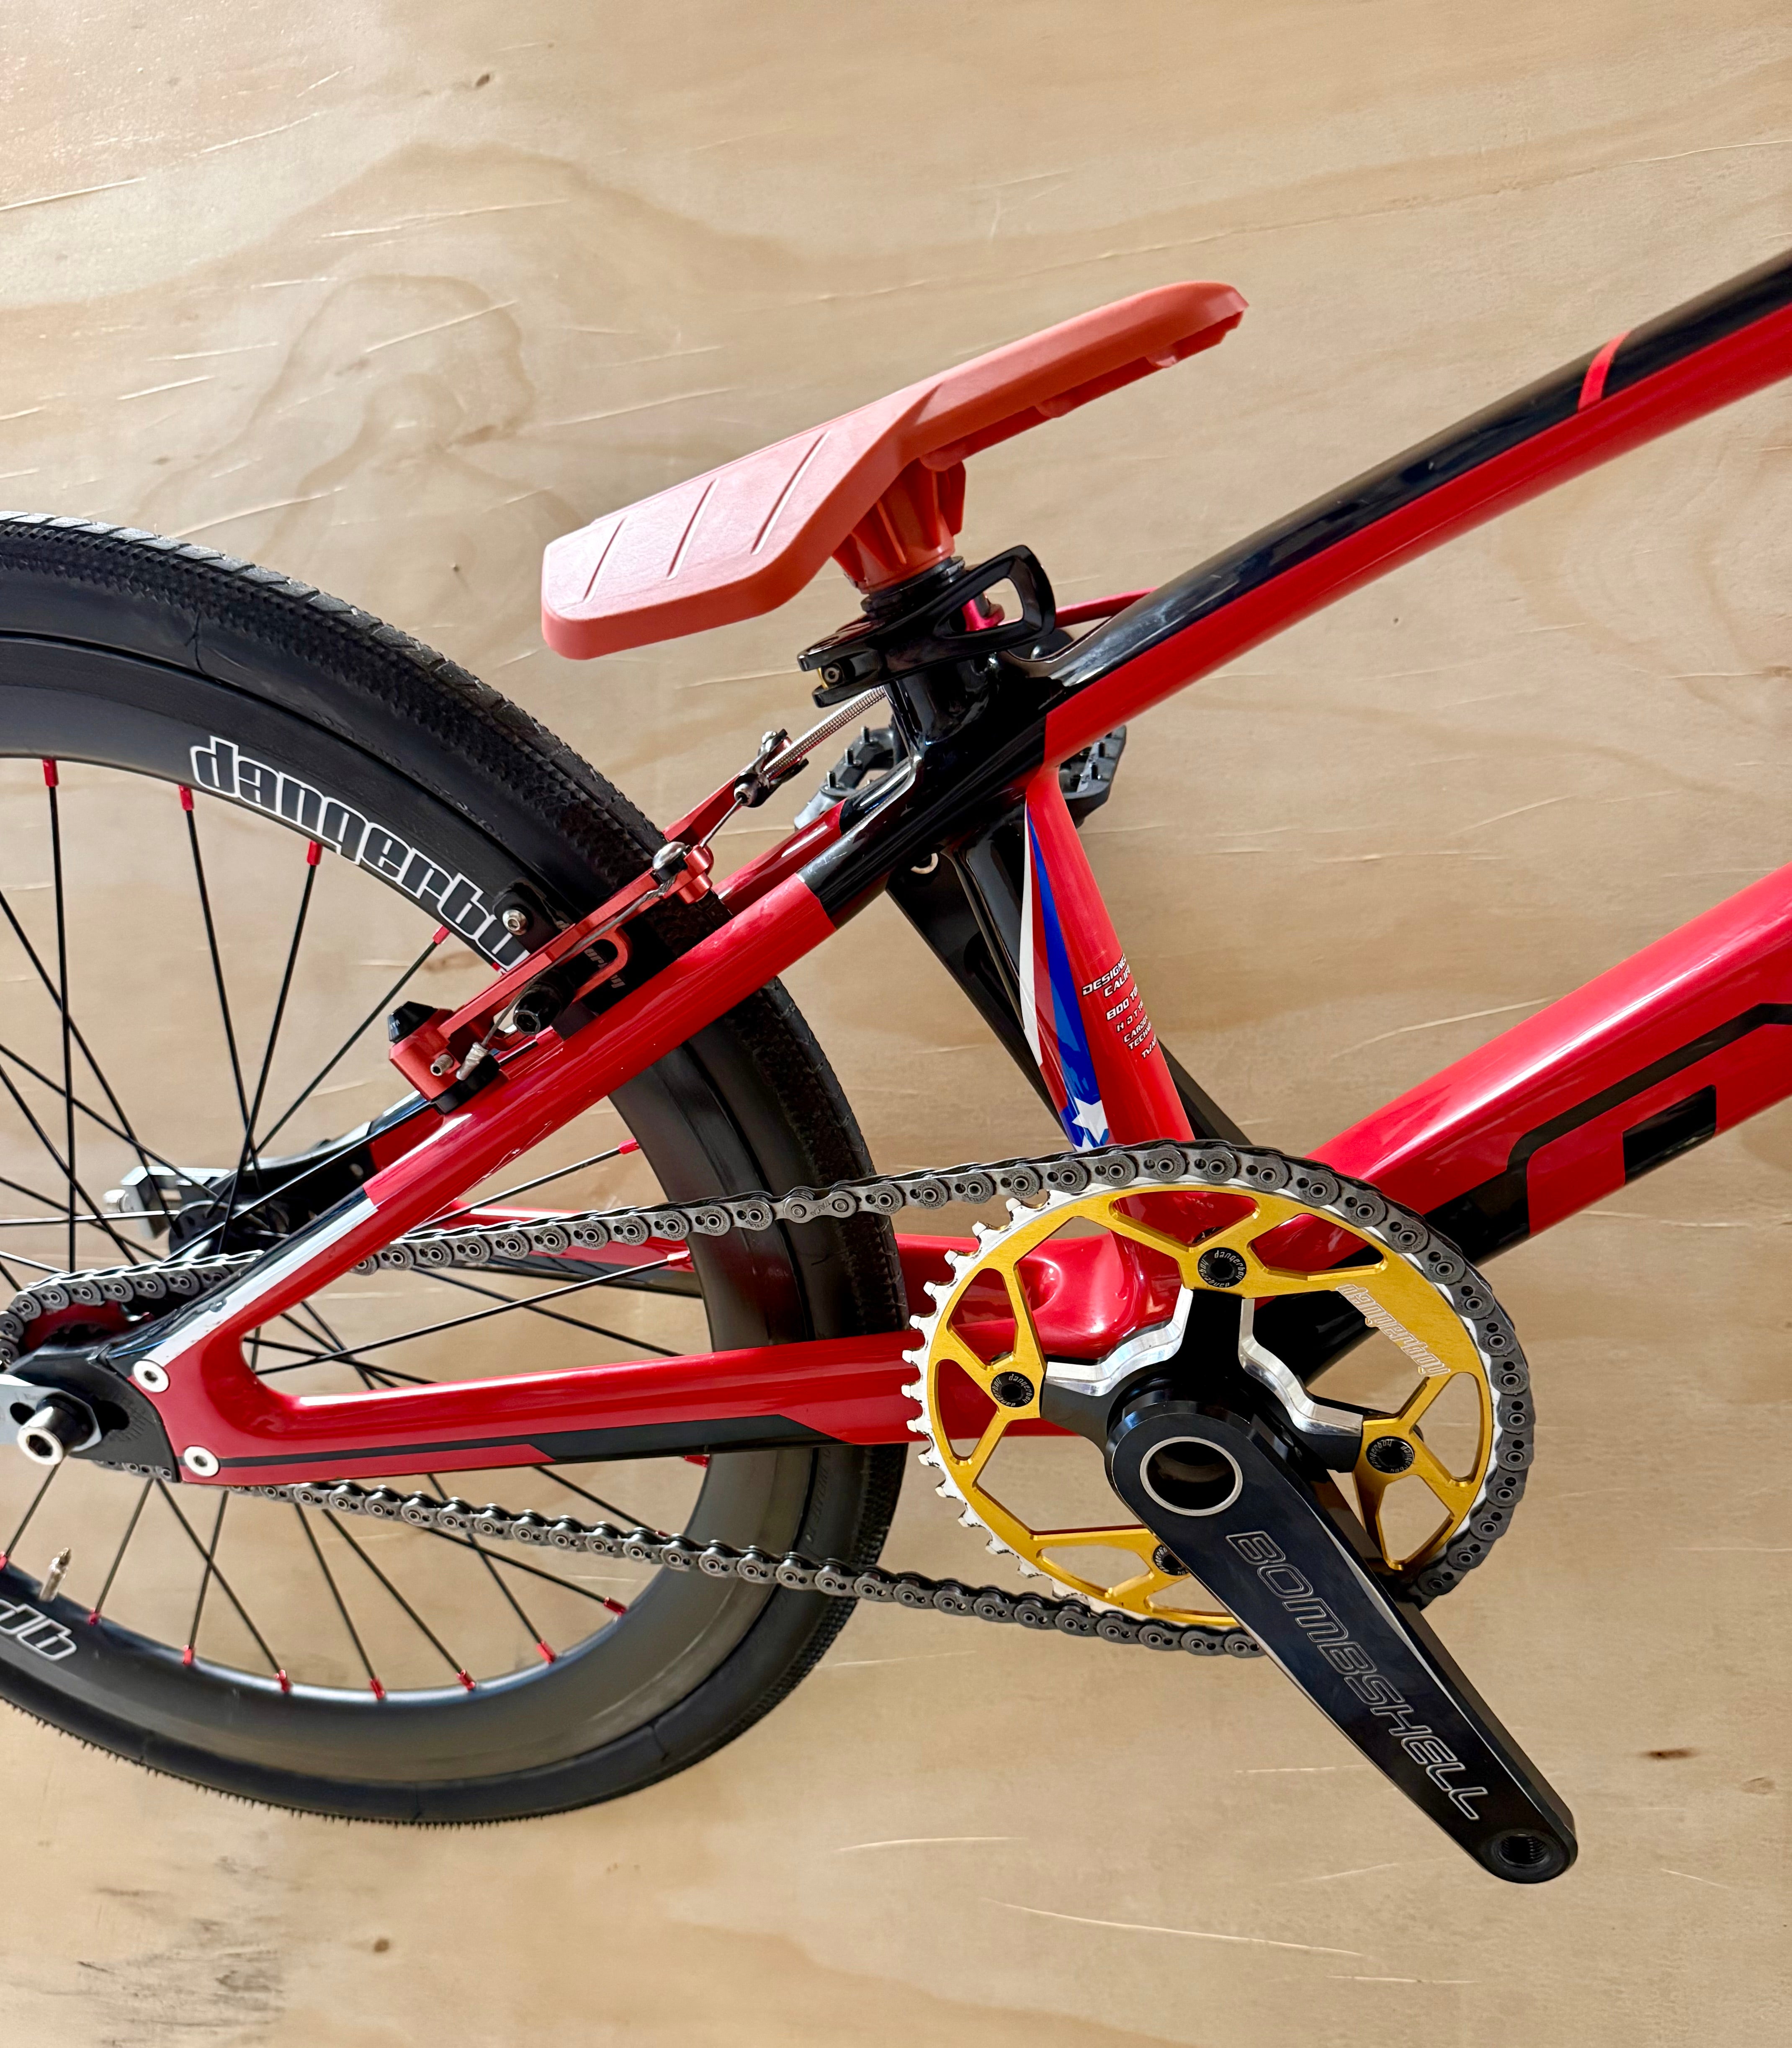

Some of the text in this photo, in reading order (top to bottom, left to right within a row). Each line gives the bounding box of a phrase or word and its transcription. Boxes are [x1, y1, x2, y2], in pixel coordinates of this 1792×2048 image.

[190, 735, 530, 972] dangerbo
[1082, 953, 1126, 996] DESIGNE
[1214, 1250, 1245, 1280] dangerboy
[1225, 1530, 1489, 1821] BOMBSHELL
